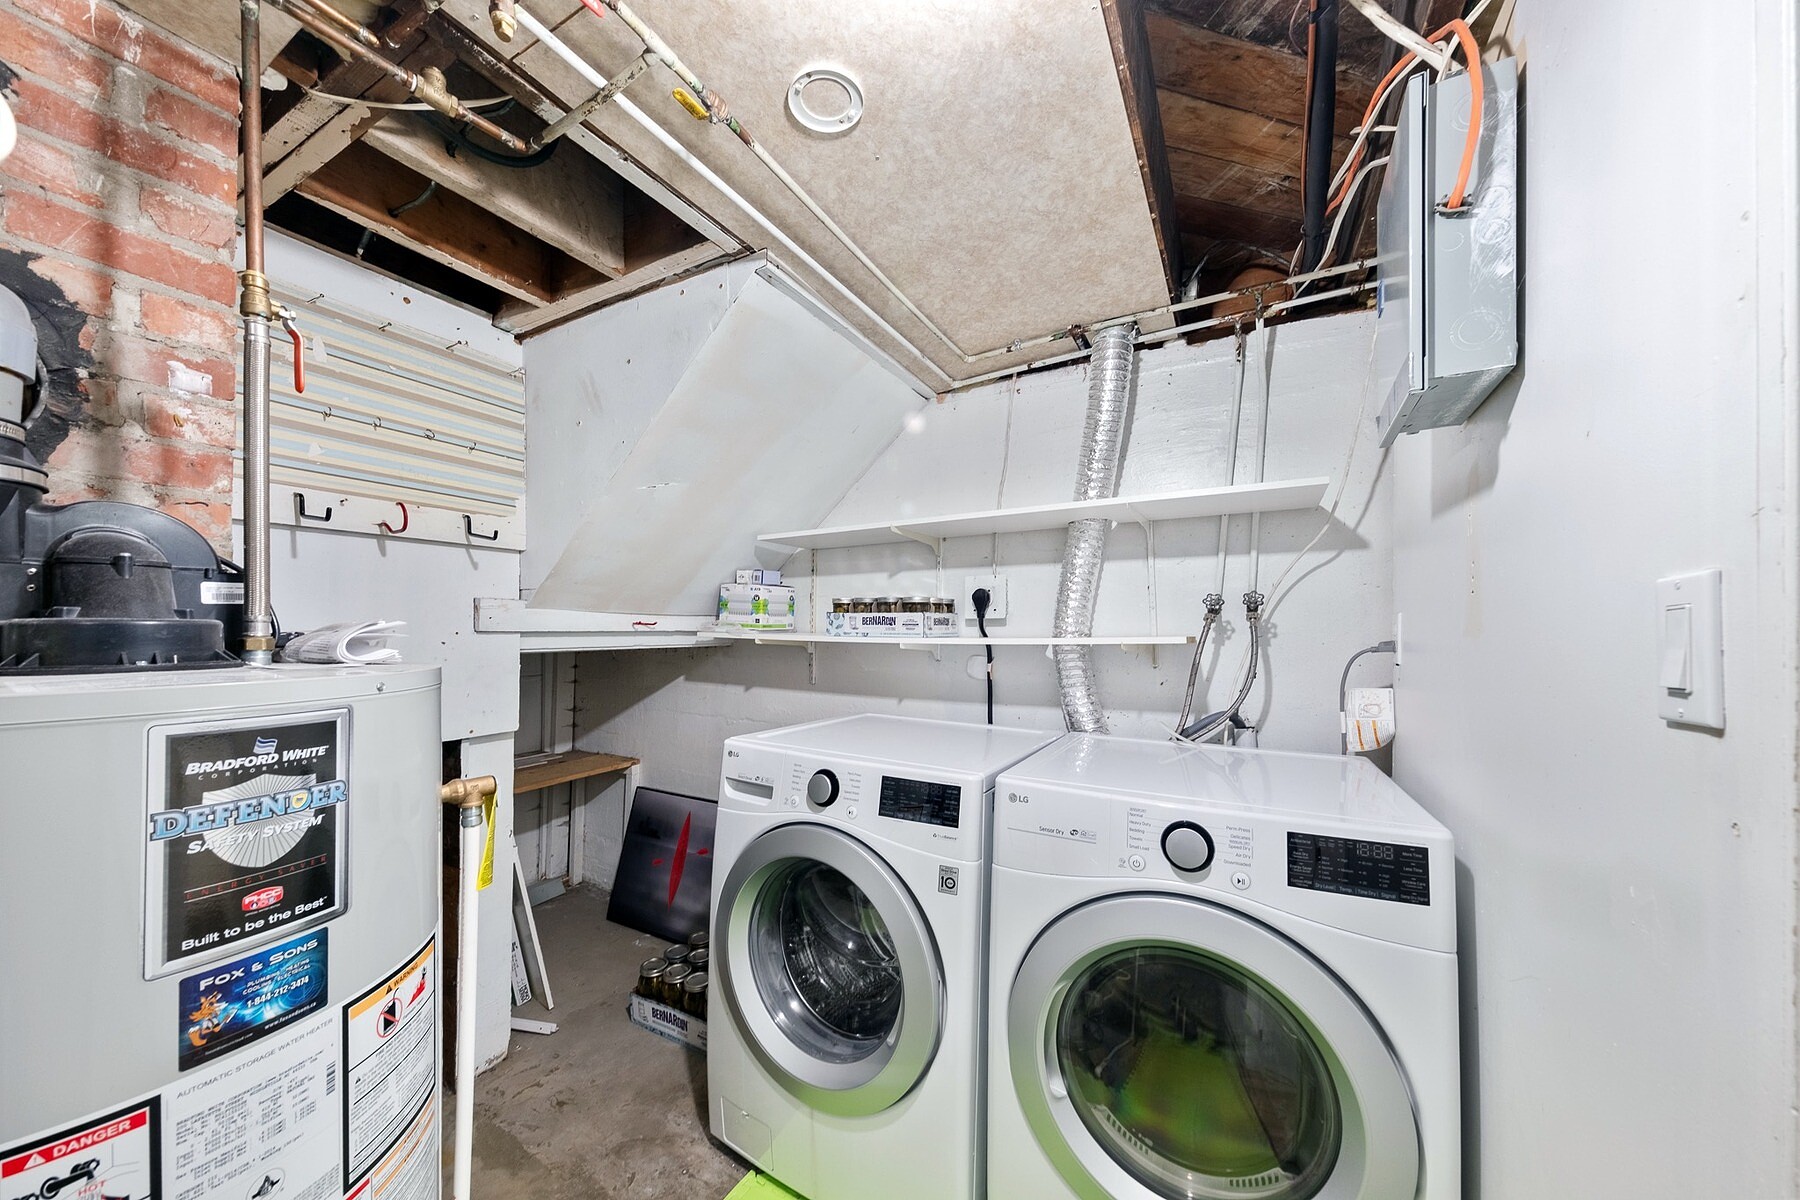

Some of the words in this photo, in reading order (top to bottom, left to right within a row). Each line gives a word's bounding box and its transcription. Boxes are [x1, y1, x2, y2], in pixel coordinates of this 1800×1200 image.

[862, 616, 896, 626] BERNARDIN
[185, 752, 279, 776] BRADFORD
[282, 746, 327, 762] WHITE
[198, 758, 318, 781] CORPORATION
[150, 780, 347, 841] DEFENDER
[1018, 795, 1029, 804] LG
[187, 829, 259, 854] SAFETY
[263, 814, 324, 838] SYSTEM
[1039, 825, 1055, 834] Sensor
[186, 874, 264, 900] ENERGY
[278, 856, 327, 876] SAVER
[941, 876, 956, 889] 10
[244, 890, 282, 904] PHCC
[182, 932, 220, 950] Built
[224, 924, 240, 936] to
[245, 918, 264, 932] be
[268, 910, 292, 924] the
[295, 899, 325, 914] Best
[200, 967, 245, 992] FOX
[251, 962, 263, 972] &
[270, 938, 318, 965] SONS
[242, 980, 272, 996] COOLING
[277, 964, 310, 982] ELECTRICAL
[247, 968, 280, 988] PLUMBING
[285, 958, 310, 970] HEATING
[393, 962, 419, 988] WARNING
[247, 976, 310, 1008] 1-844-212-3474
[652, 1006, 688, 1032] BERNARDIN
[176, 1068, 233, 1099] AUTOMATIC
[235, 1048, 276, 1072] STORAGE
[278, 1034, 305, 1052] WATER
[306, 1018, 334, 1036] HEATER
[52, 1119, 132, 1158] DANGER
[78, 1180, 107, 1197] HOT
